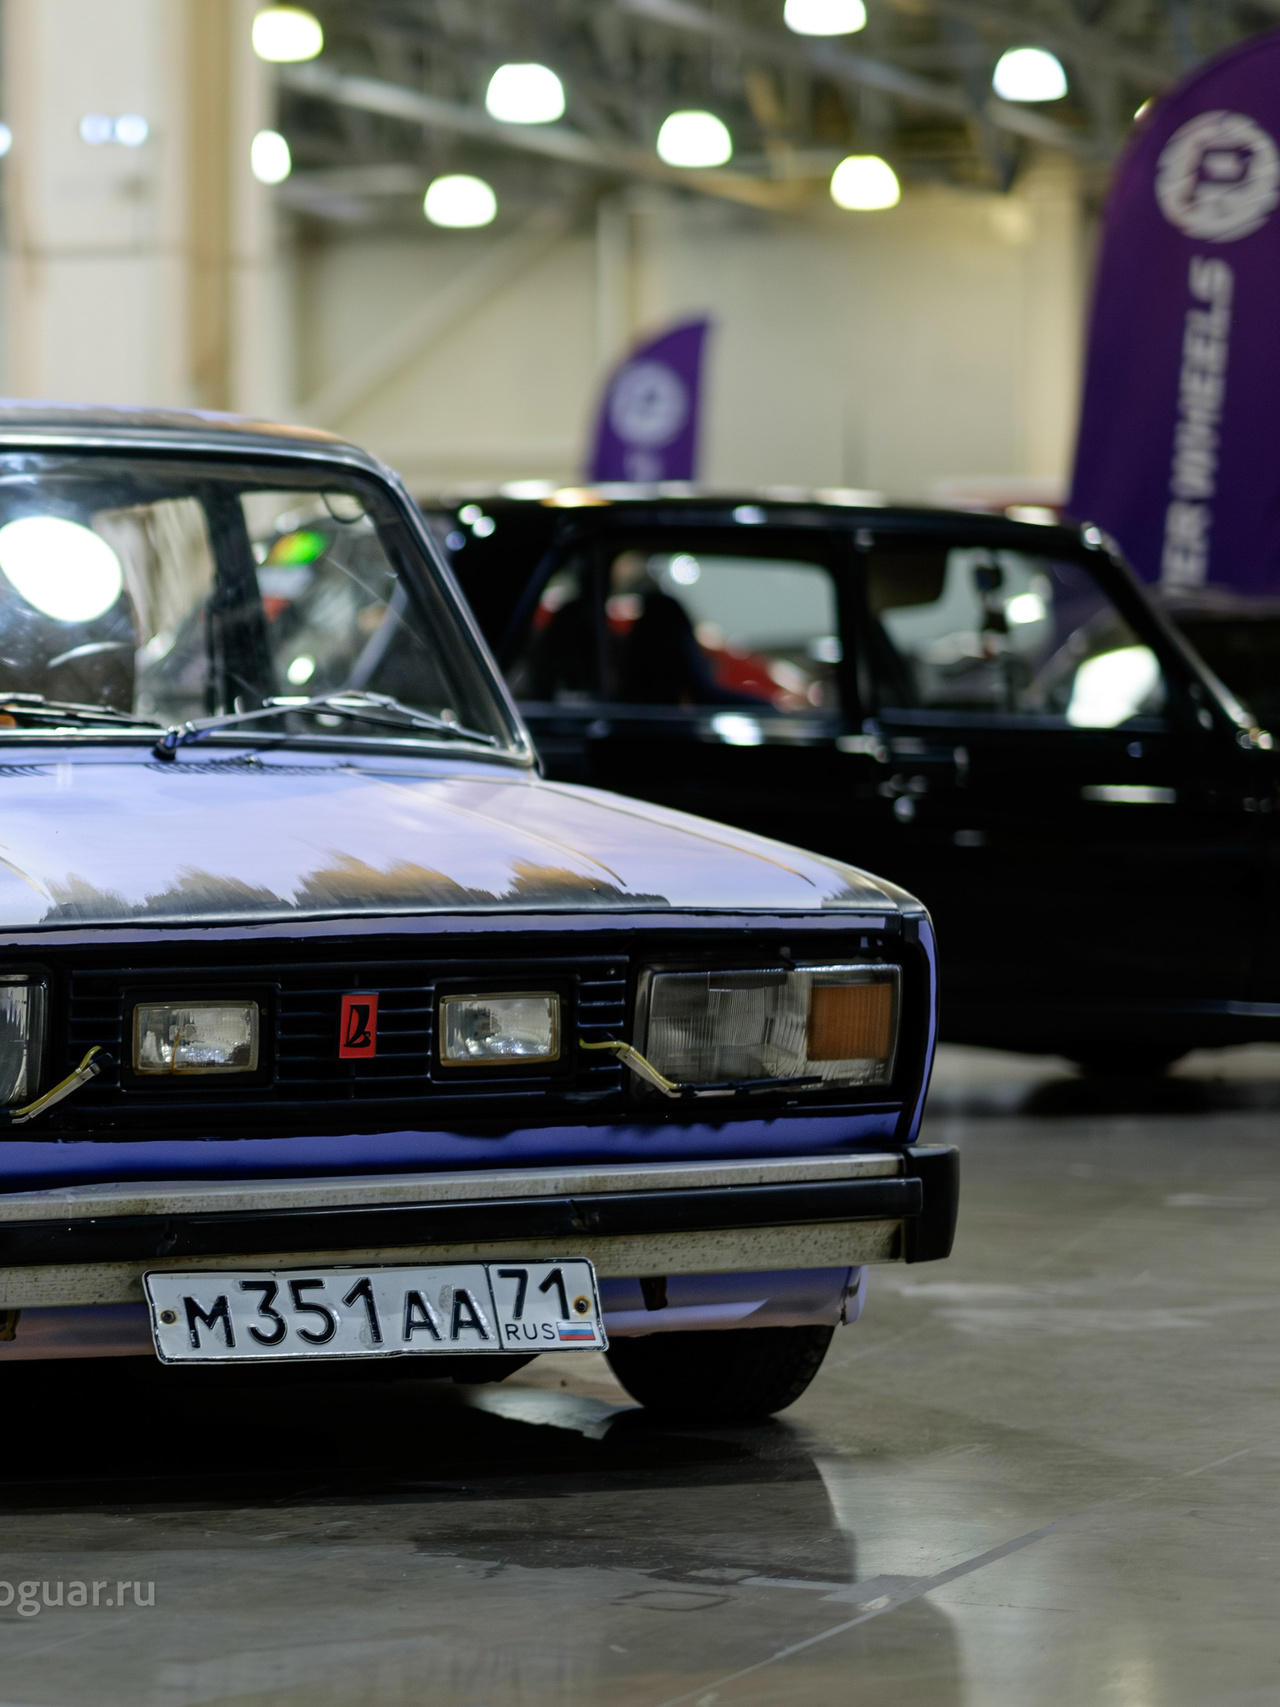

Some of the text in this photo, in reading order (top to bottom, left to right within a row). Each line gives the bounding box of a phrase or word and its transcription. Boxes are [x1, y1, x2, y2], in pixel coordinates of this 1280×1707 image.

[1169, 256, 1234, 499] WHEELS
[497, 1268, 570, 1320] 71
[504, 1323, 556, 1341] RUS
